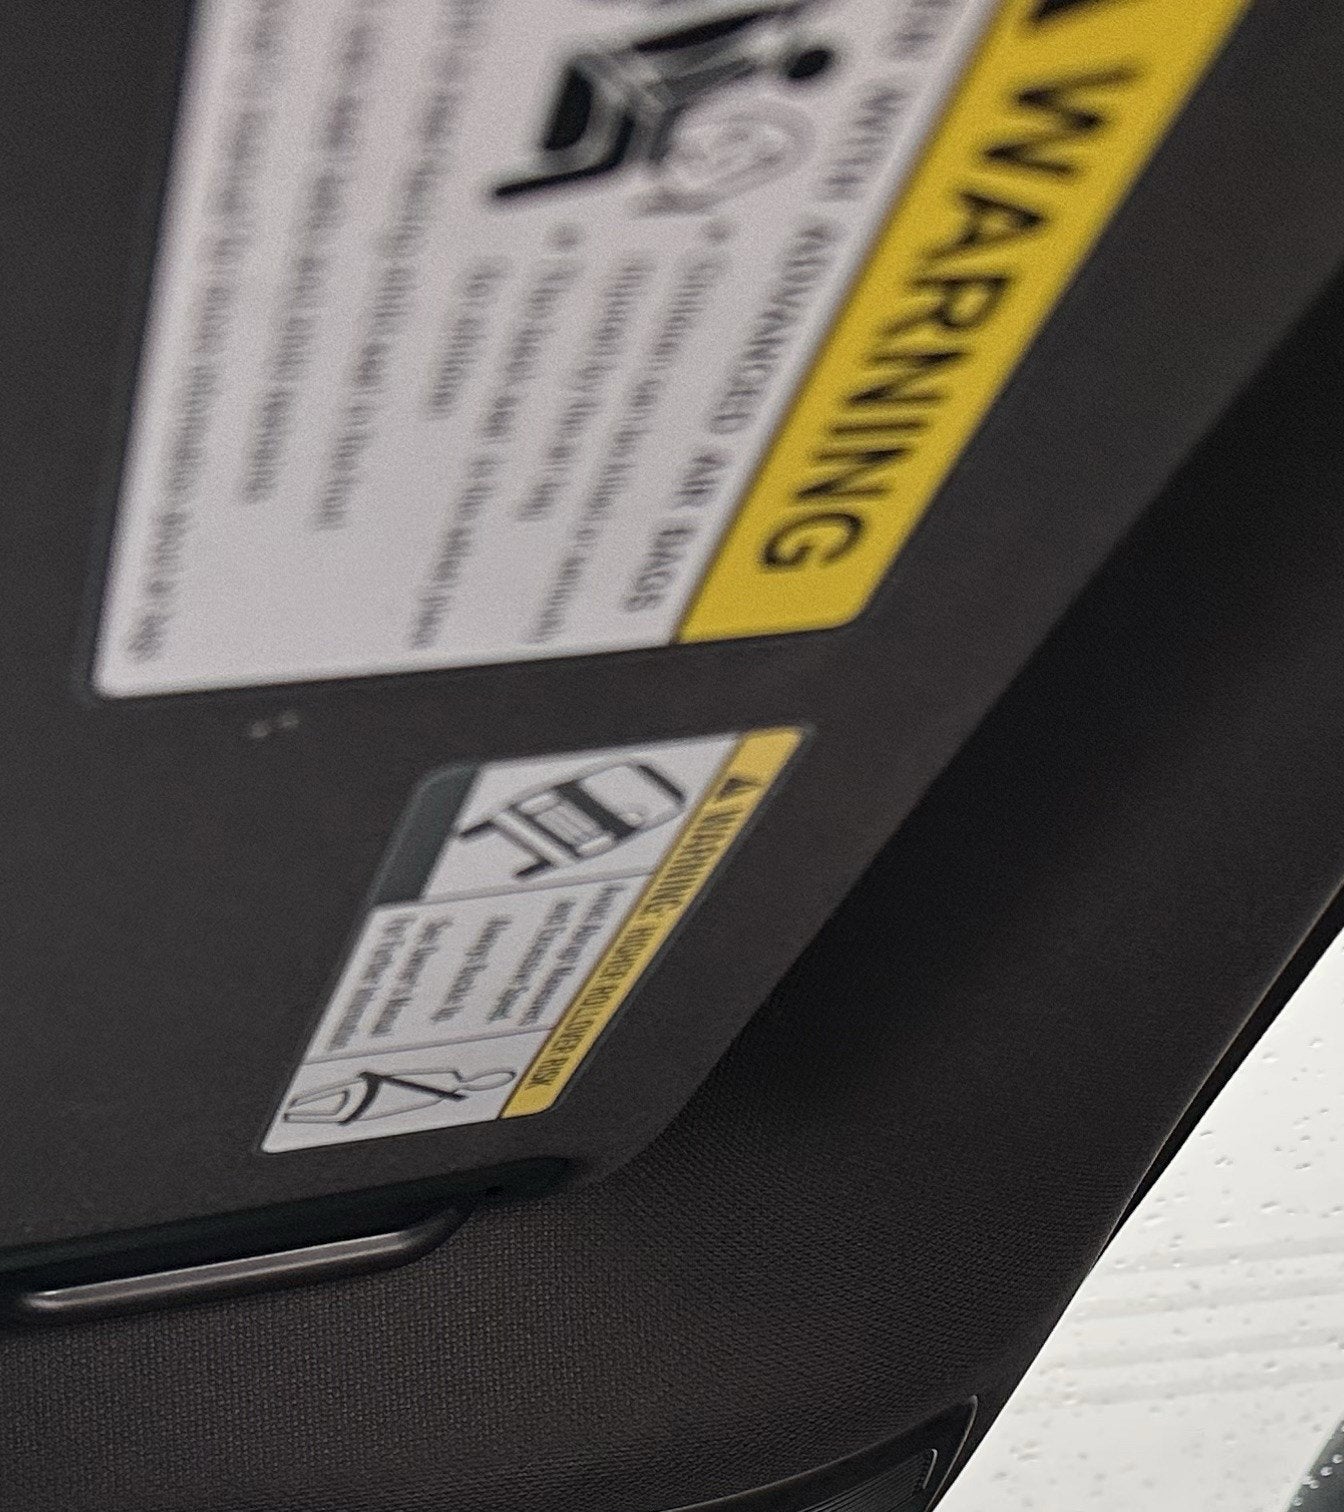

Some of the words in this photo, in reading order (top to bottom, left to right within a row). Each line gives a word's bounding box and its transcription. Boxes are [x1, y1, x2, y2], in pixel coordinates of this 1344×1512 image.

[701, 222, 849, 437] ADVANCED
[761, 57, 1146, 572] WARNING
[666, 450, 737, 511] AIR
[618, 525, 700, 613] BAGS
[593, 924, 661, 984] HIGHER
[547, 984, 620, 1055] ROLLOVER
[523, 1056, 571, 1089] RISK
